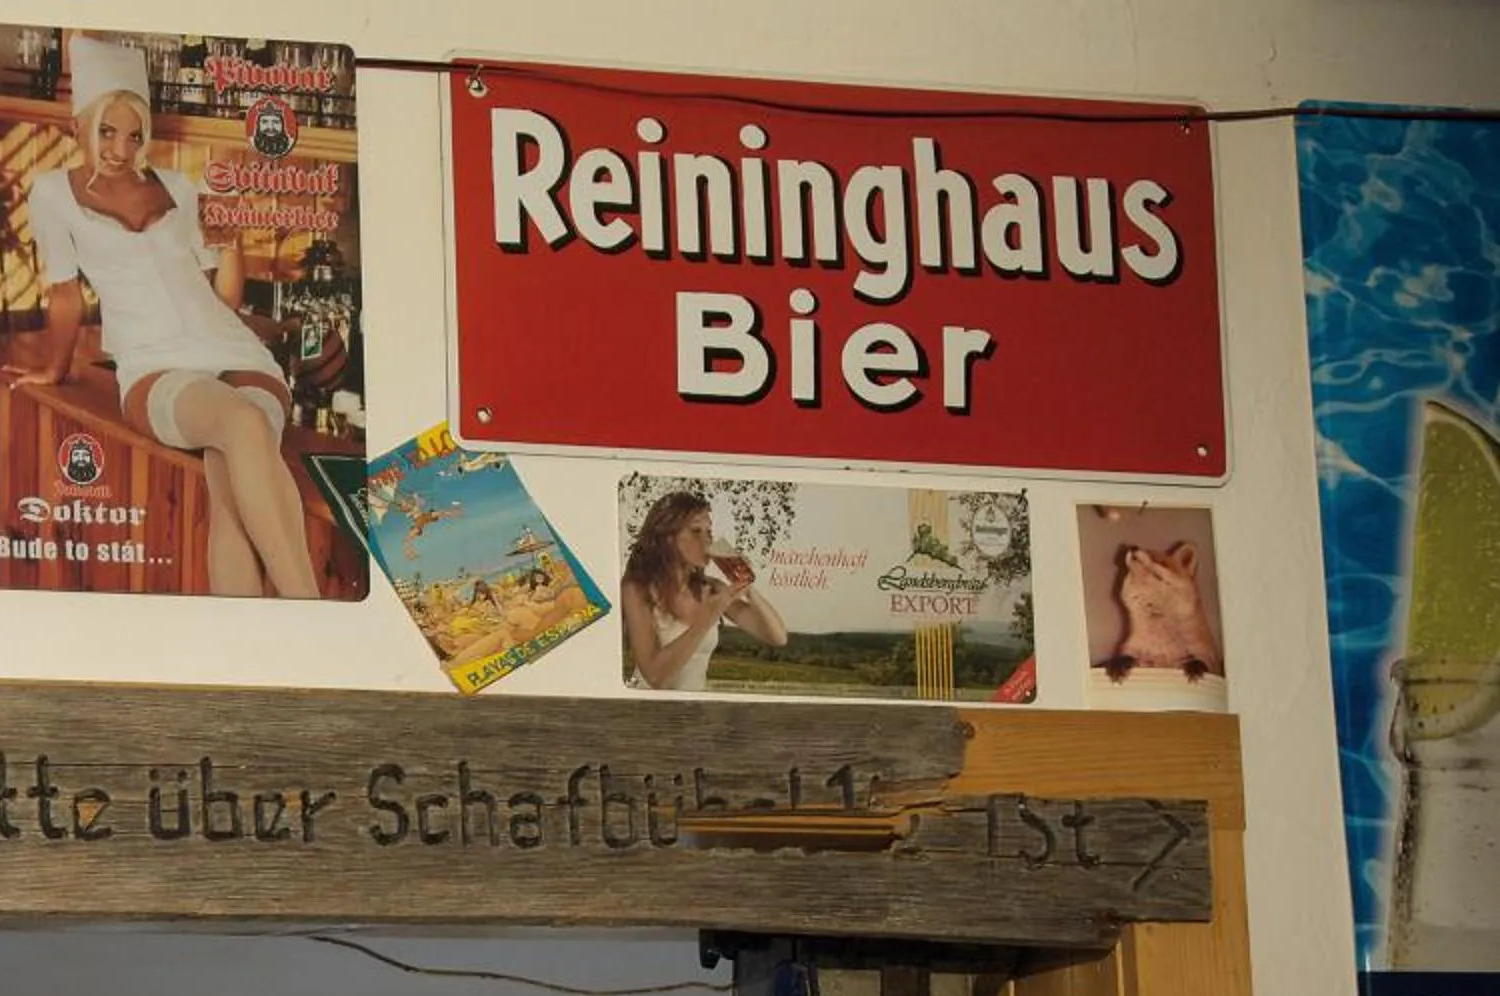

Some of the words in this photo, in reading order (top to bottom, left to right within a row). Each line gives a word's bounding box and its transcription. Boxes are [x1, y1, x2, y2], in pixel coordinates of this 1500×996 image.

[491, 107, 1181, 302] Reininghaus
[676, 289, 992, 413] Bier
[17, 497, 147, 527] Doktor
[65, 539, 89, 561] to
[889, 594, 979, 616] EXPORT
[144, 754, 338, 847] über
